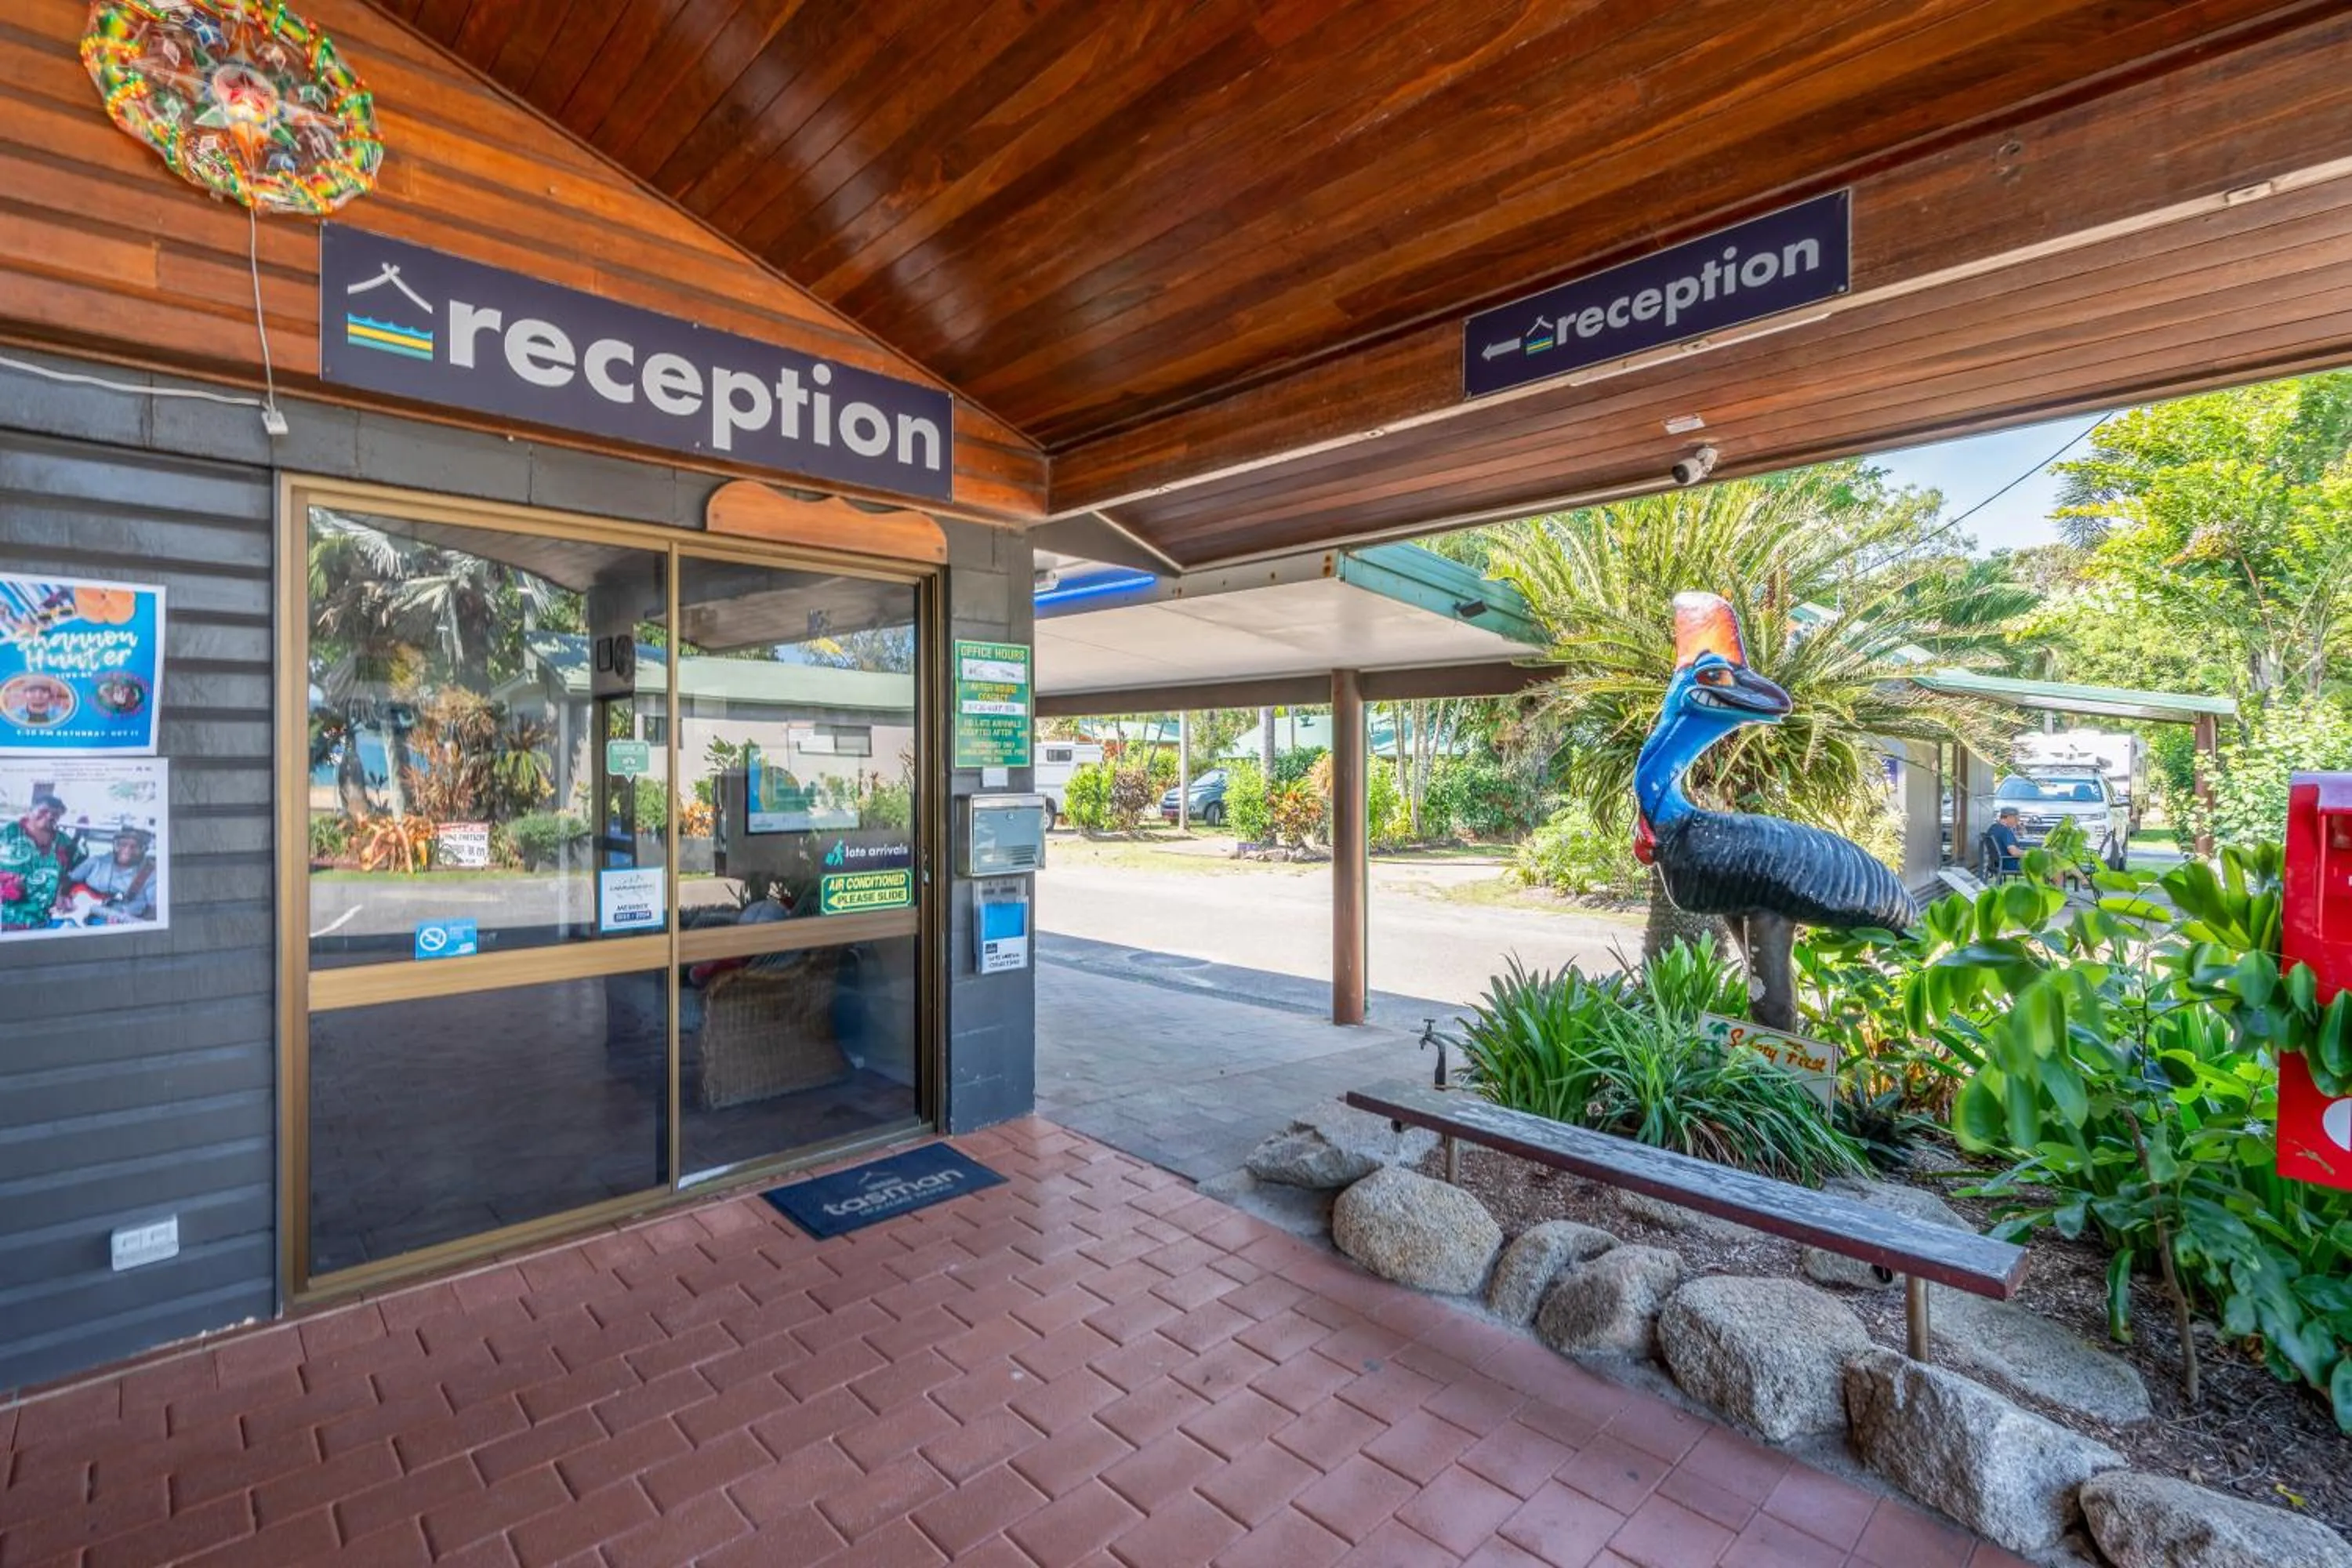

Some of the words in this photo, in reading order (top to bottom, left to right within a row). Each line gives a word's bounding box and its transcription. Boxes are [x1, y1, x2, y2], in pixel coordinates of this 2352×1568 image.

[1557, 238, 1820, 345] reception
[449, 299, 940, 470] reception
[16, 626, 139, 652] Shannon
[26, 648, 132, 672] Hunter
[961, 646, 992, 659] OFFICE
[995, 648, 1025, 660] HOURS
[845, 845, 866, 858] late
[868, 844, 908, 857] arrivals
[829, 877, 844, 891] AIR
[846, 873, 906, 890] CONDITIONED
[837, 891, 875, 905] PLEASE
[877, 890, 905, 901] SLIDE
[822, 1169, 966, 1215] tasman
